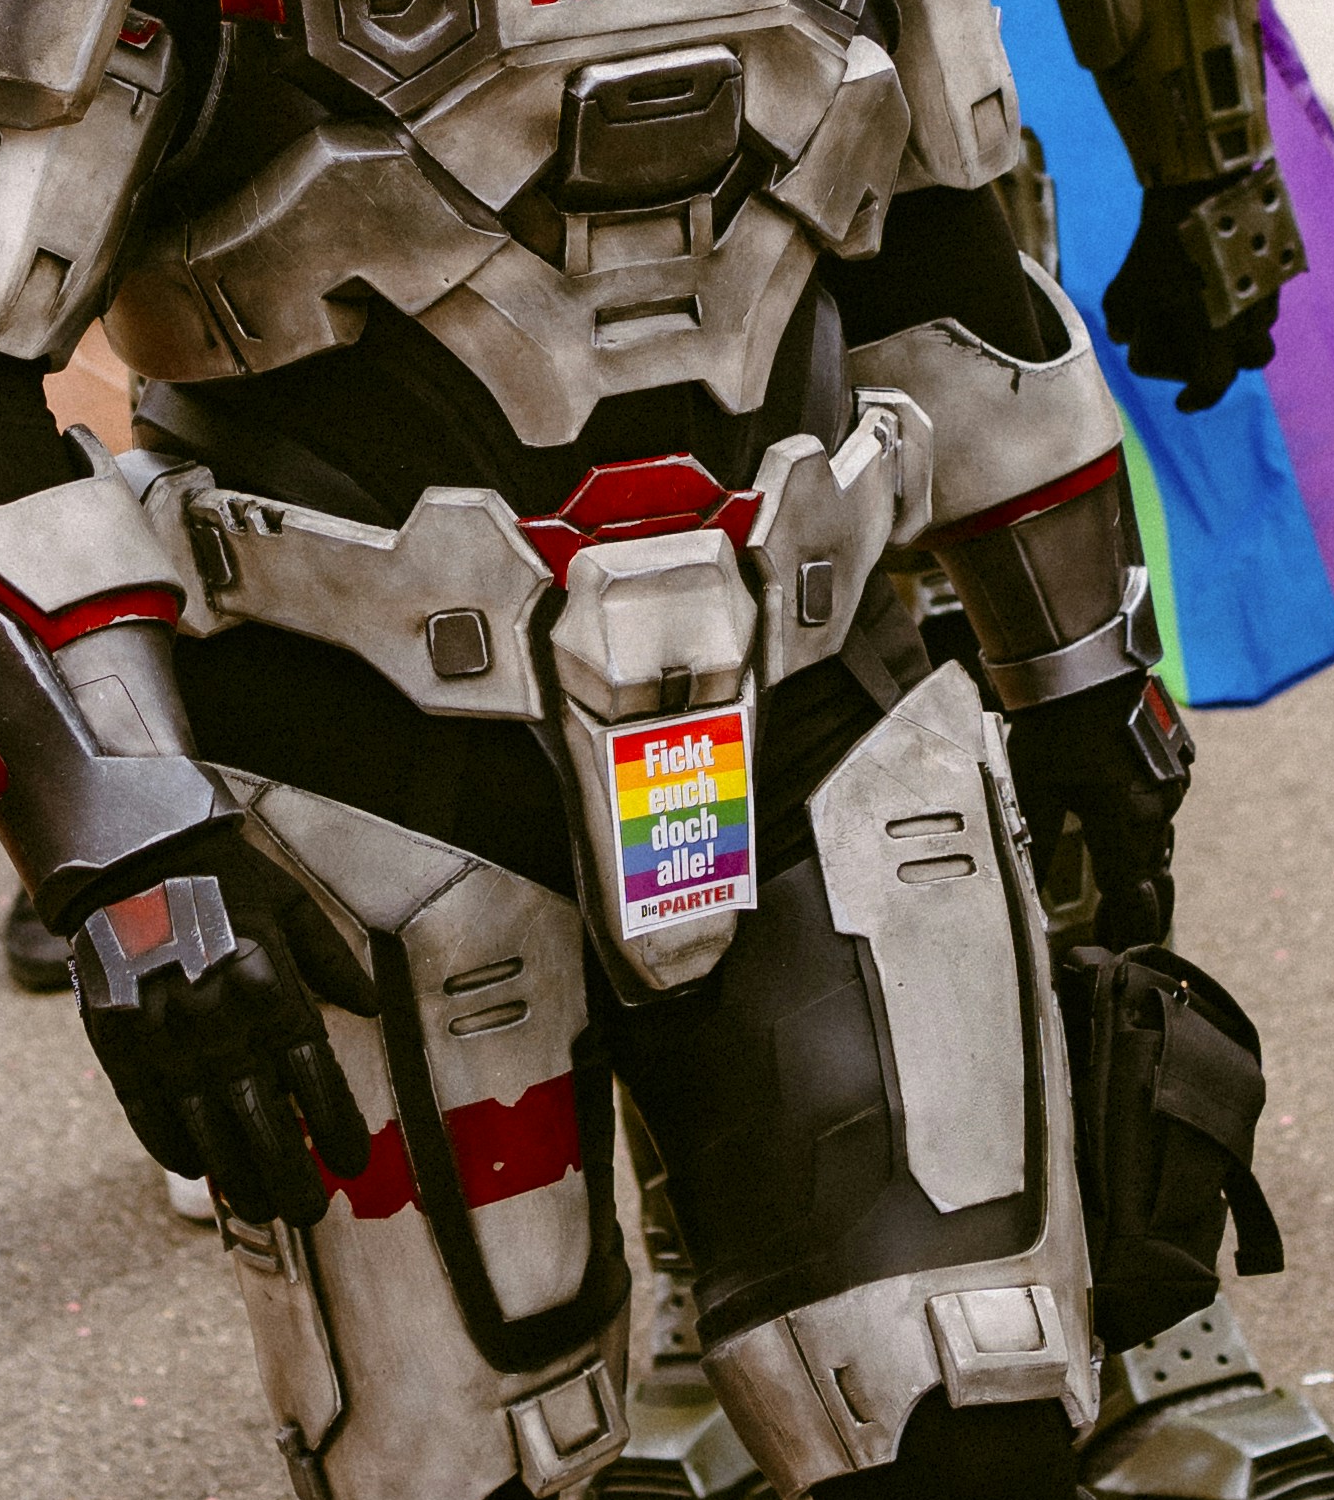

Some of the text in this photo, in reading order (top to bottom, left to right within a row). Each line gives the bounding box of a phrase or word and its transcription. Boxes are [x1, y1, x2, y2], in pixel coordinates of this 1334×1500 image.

[645, 734, 715, 778] Fickt
[649, 771, 717, 815] euch
[651, 807, 718, 851] doch
[657, 842, 715, 887] alle!
